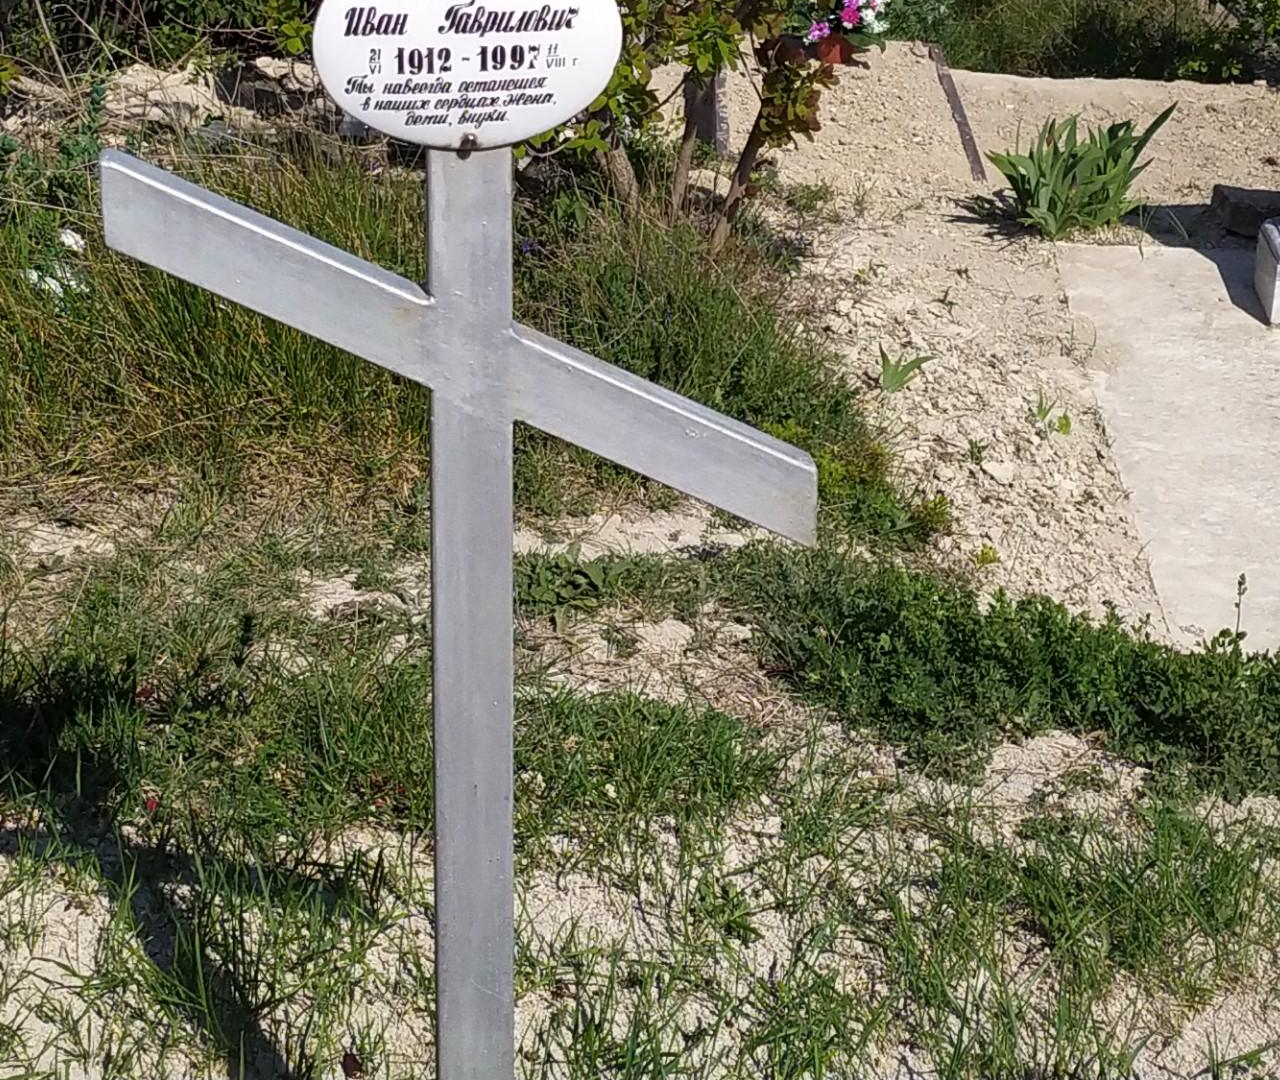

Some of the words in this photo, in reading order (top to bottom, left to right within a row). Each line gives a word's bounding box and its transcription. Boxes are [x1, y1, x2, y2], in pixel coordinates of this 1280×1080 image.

[344, 6, 409, 37] Иван
[394, 46, 453, 76] 1912
[344, 74, 375, 96] Ты
[382, 76, 454, 96] навсегда
[360, 97, 371, 111] в
[373, 98, 430, 113] наших
[502, 92, 558, 108] Жена,
[404, 110, 453, 128] дети,
